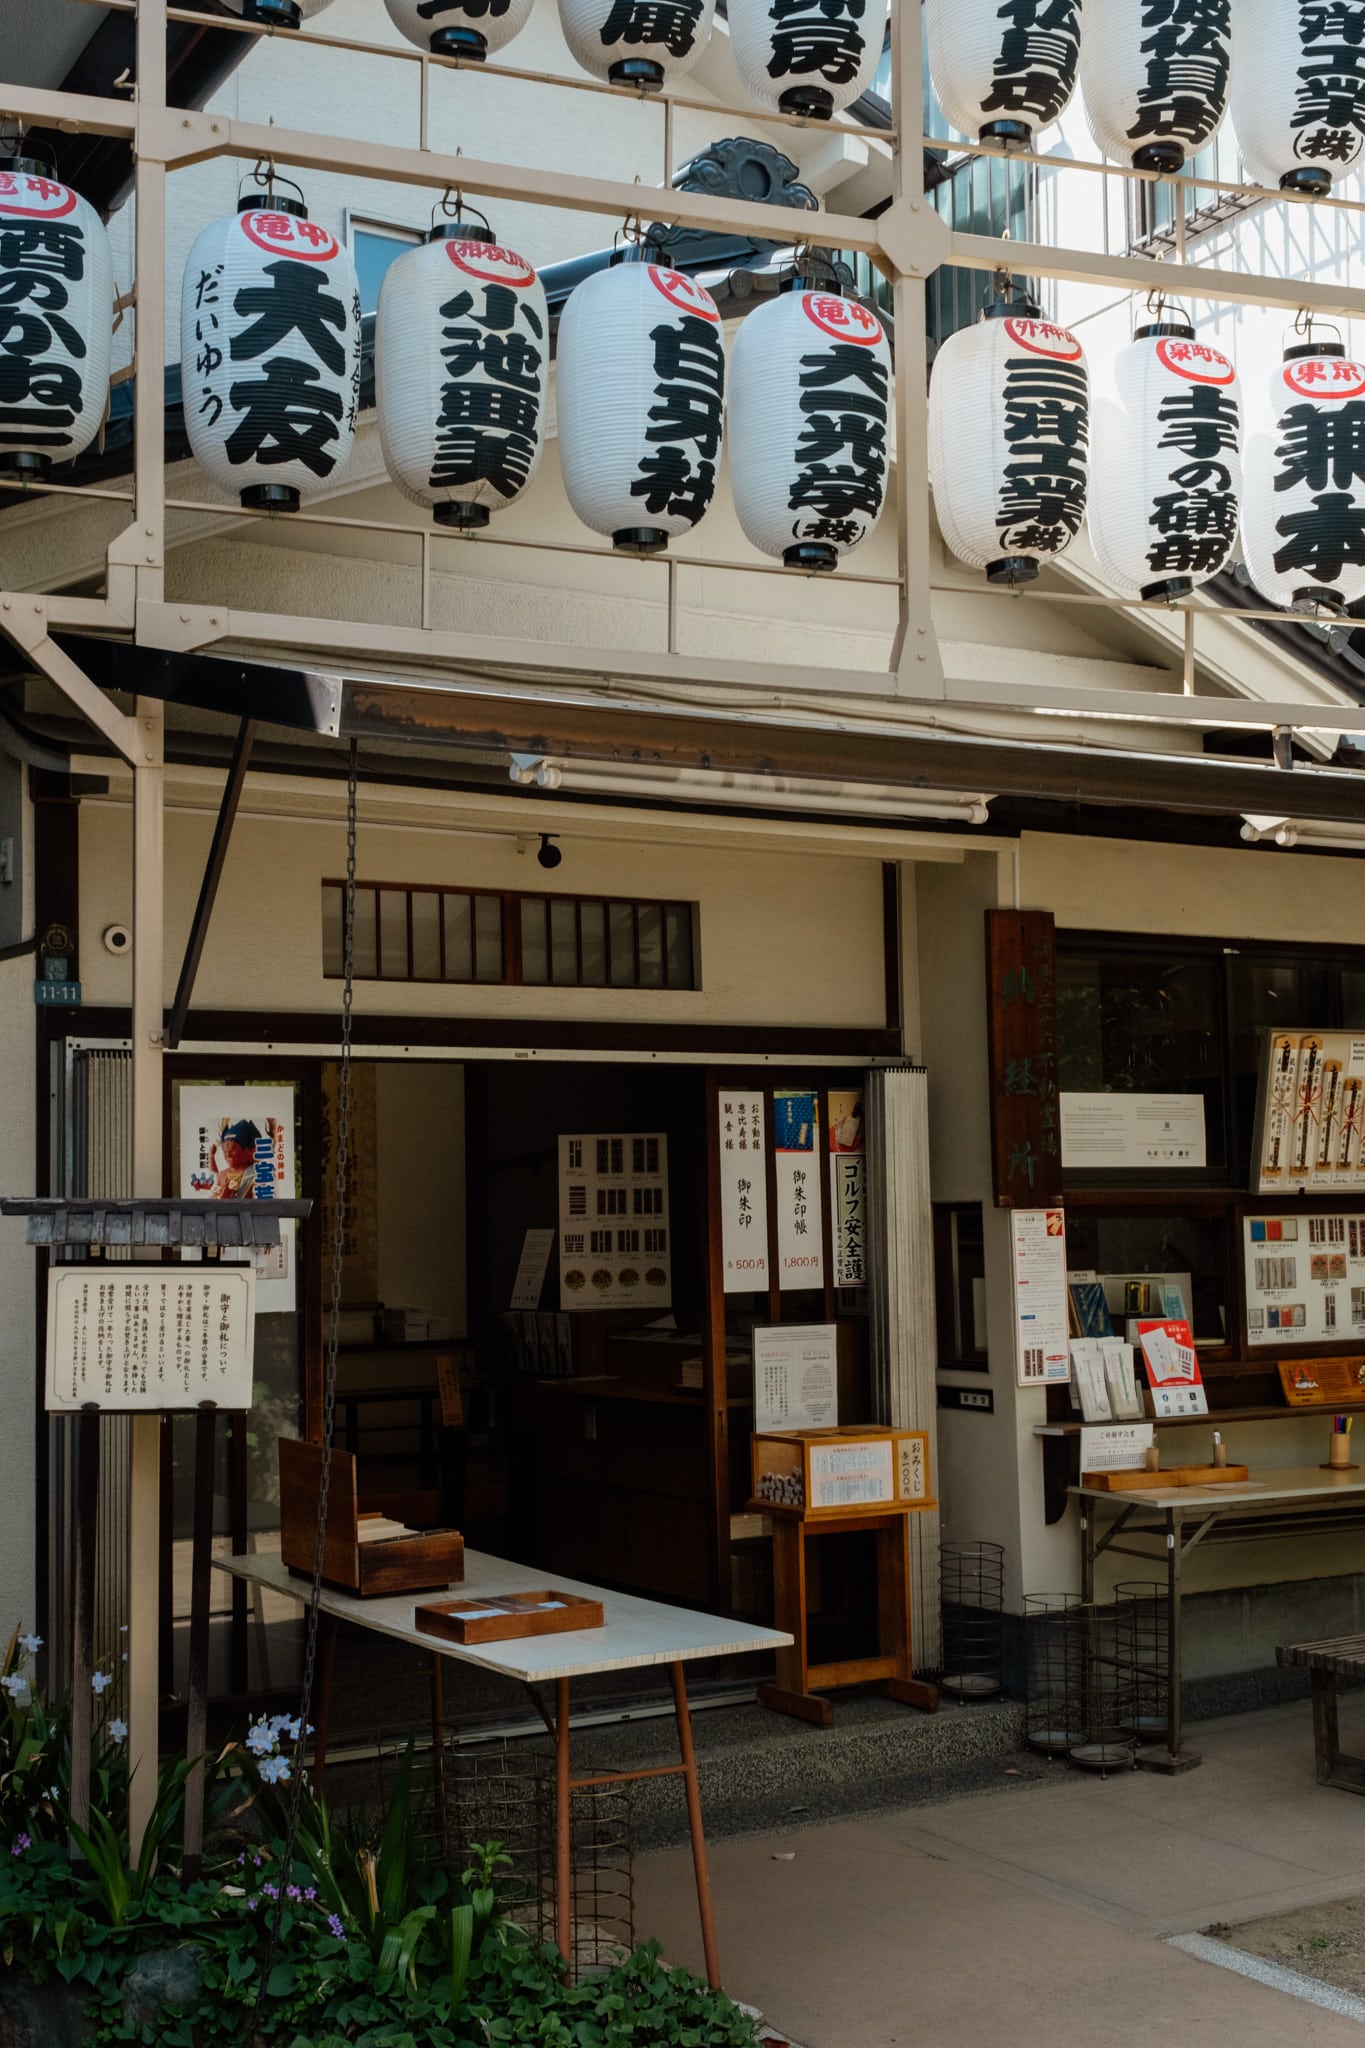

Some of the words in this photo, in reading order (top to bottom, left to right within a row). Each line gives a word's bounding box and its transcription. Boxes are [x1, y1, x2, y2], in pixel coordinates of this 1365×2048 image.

[1290, 0, 1365, 165] 洋工業(株)
[195, 265, 225, 427] だいゆう
[1296, 361, 1364, 384] 東京
[41, 985, 76, 1000] 11-11
[276, 1125, 285, 1180] かまどの神様
[737, 1178, 752, 1229] 御朱印
[792, 1169, 808, 1235] 御朱印帳
[783, 1257, 819, 1269] 1,800円
[219, 1293, 231, 1375] 御守と御札について
[911, 1441, 922, 1493] おみくじ
